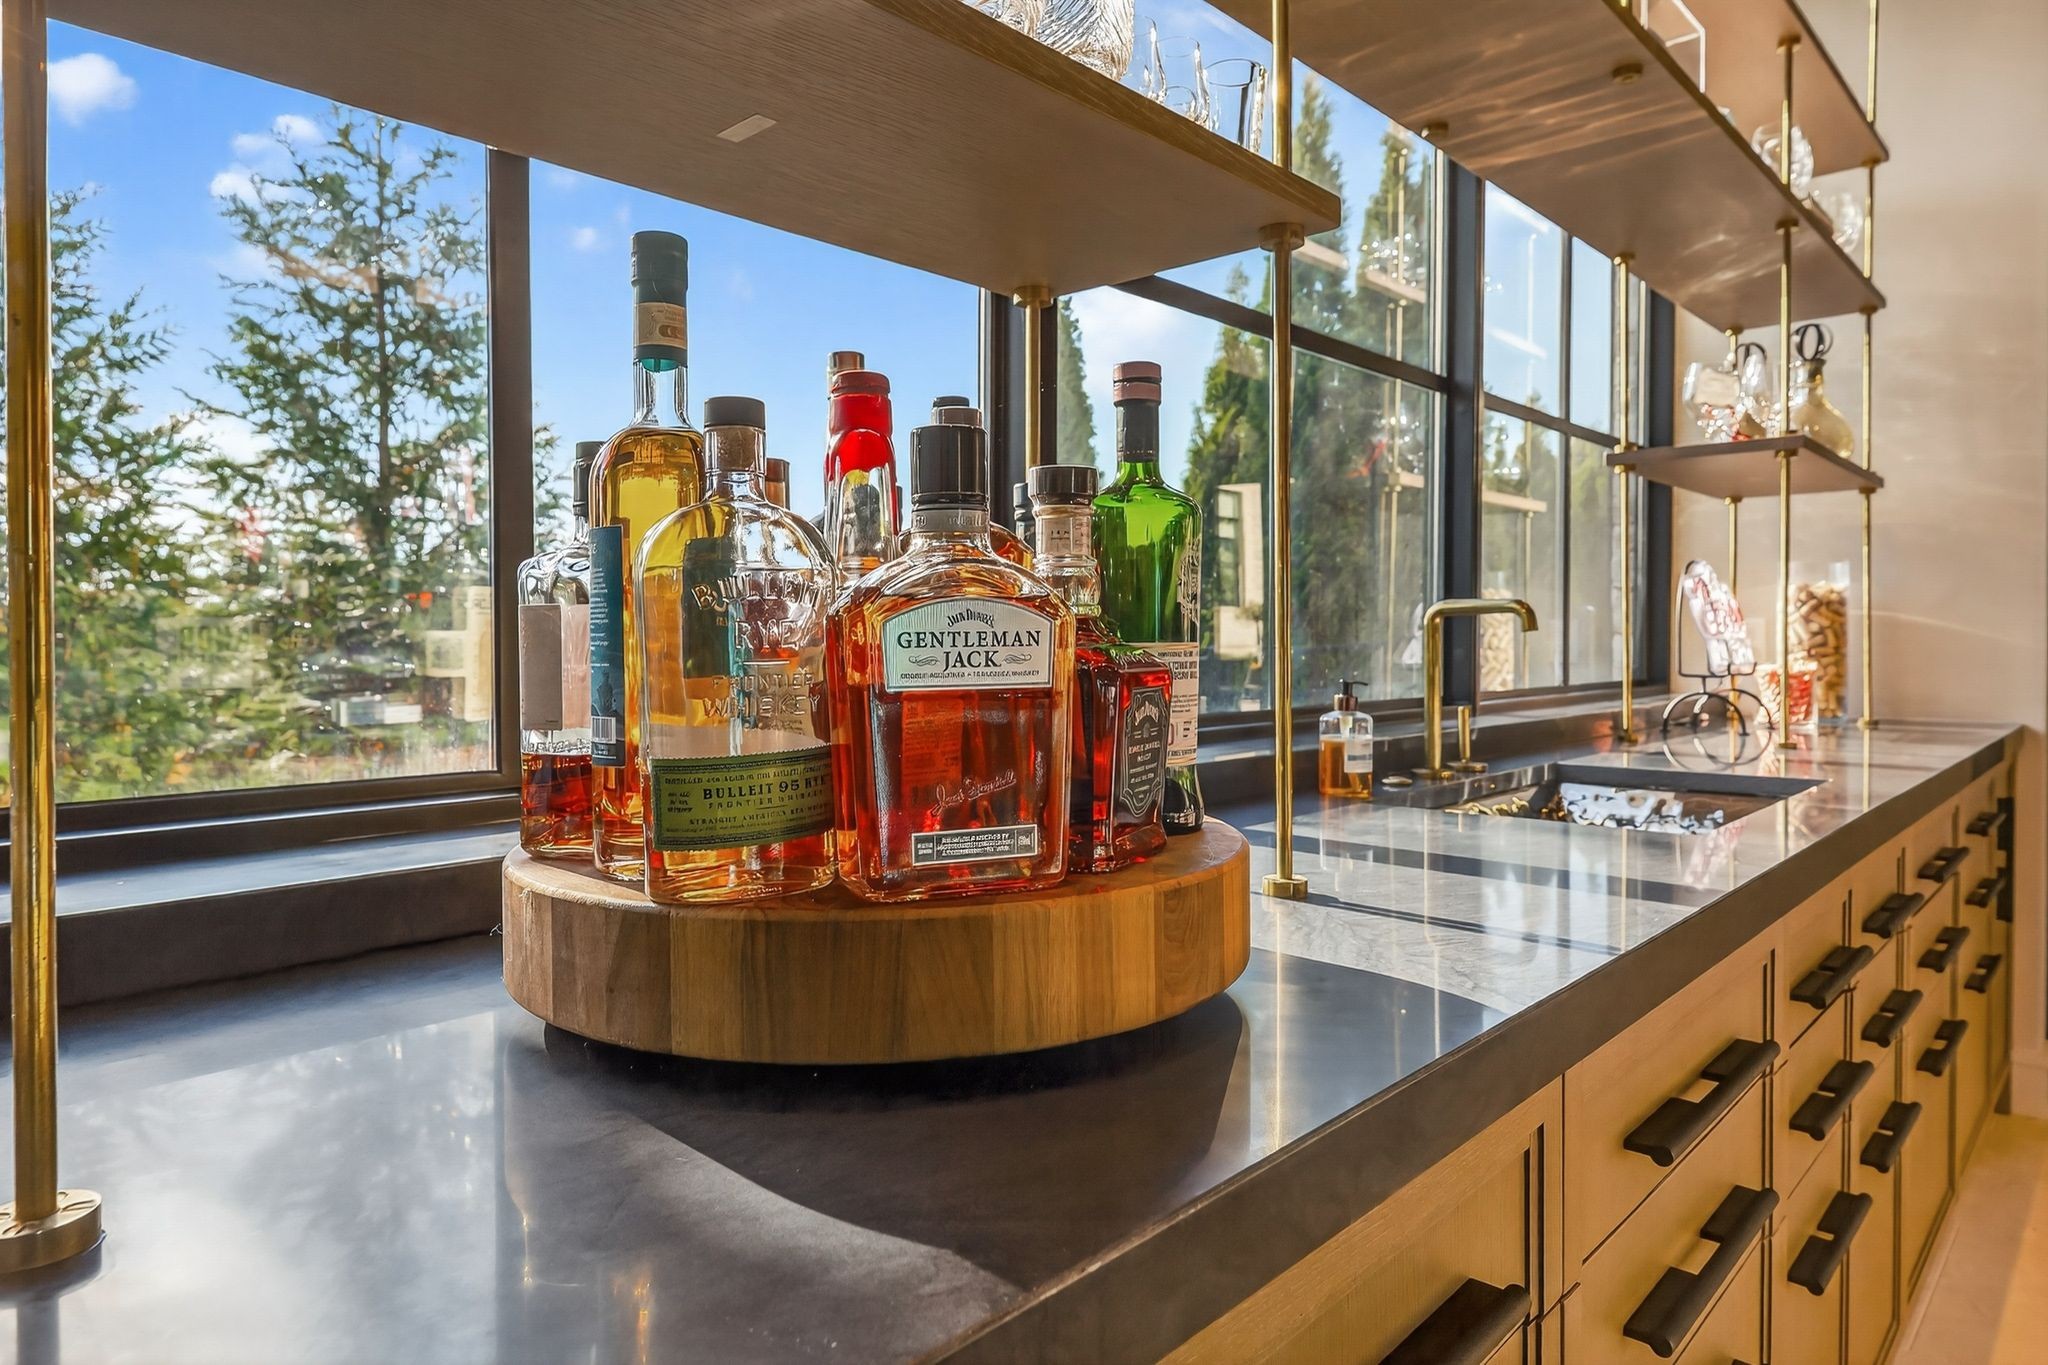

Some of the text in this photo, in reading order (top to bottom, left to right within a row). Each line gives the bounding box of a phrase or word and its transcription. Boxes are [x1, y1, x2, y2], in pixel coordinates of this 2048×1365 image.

[897, 630, 1042, 649] GENTLEMAN
[943, 650, 1002, 672] JACK
[703, 782, 773, 800] BULLEIT
[778, 780, 800, 793] 95
